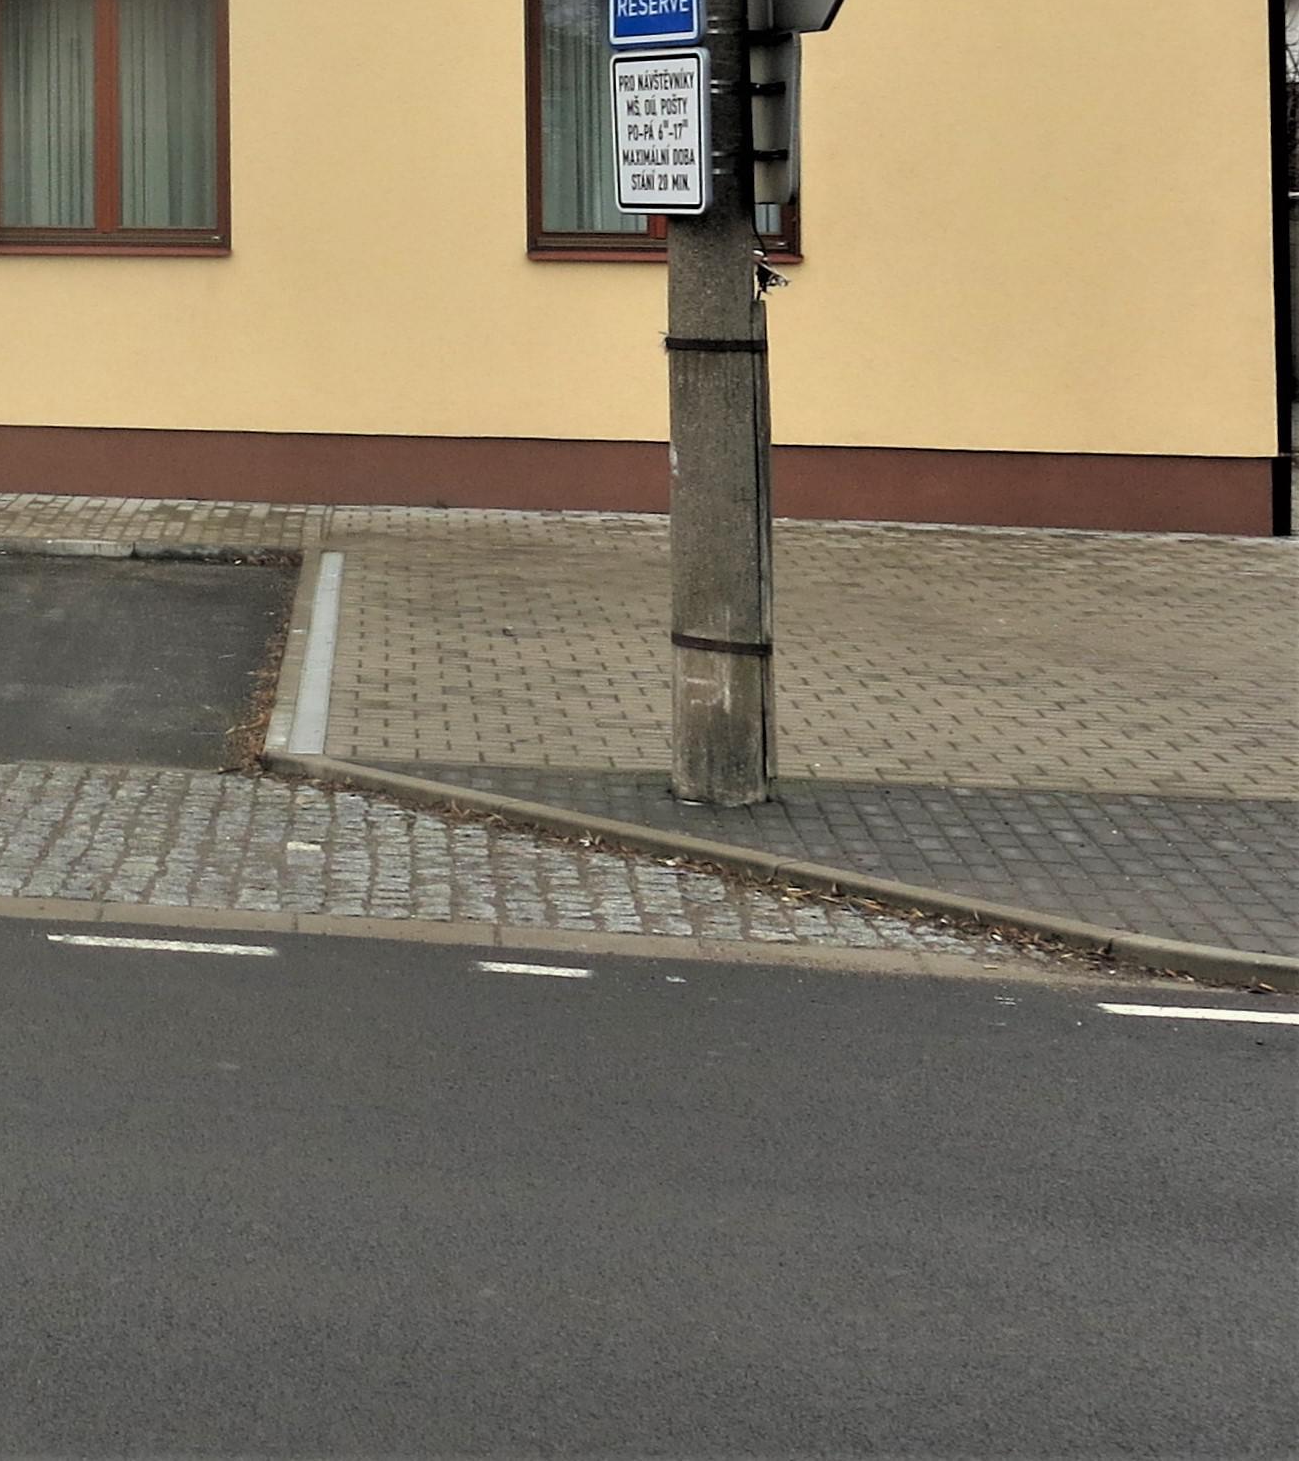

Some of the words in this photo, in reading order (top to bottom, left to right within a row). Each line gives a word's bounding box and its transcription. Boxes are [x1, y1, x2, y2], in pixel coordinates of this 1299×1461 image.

[618, 75, 635, 92] PRO
[638, 68, 694, 90] NÁVŠTĚVNÍKY
[661, 94, 687, 115] POŠTY
[627, 120, 654, 141] PO-PÁ
[622, 144, 669, 166] MAXIMÁLNÍ
[673, 148, 695, 166] DOBA
[631, 170, 654, 190] STÁNÍ
[658, 174, 668, 190] 20
